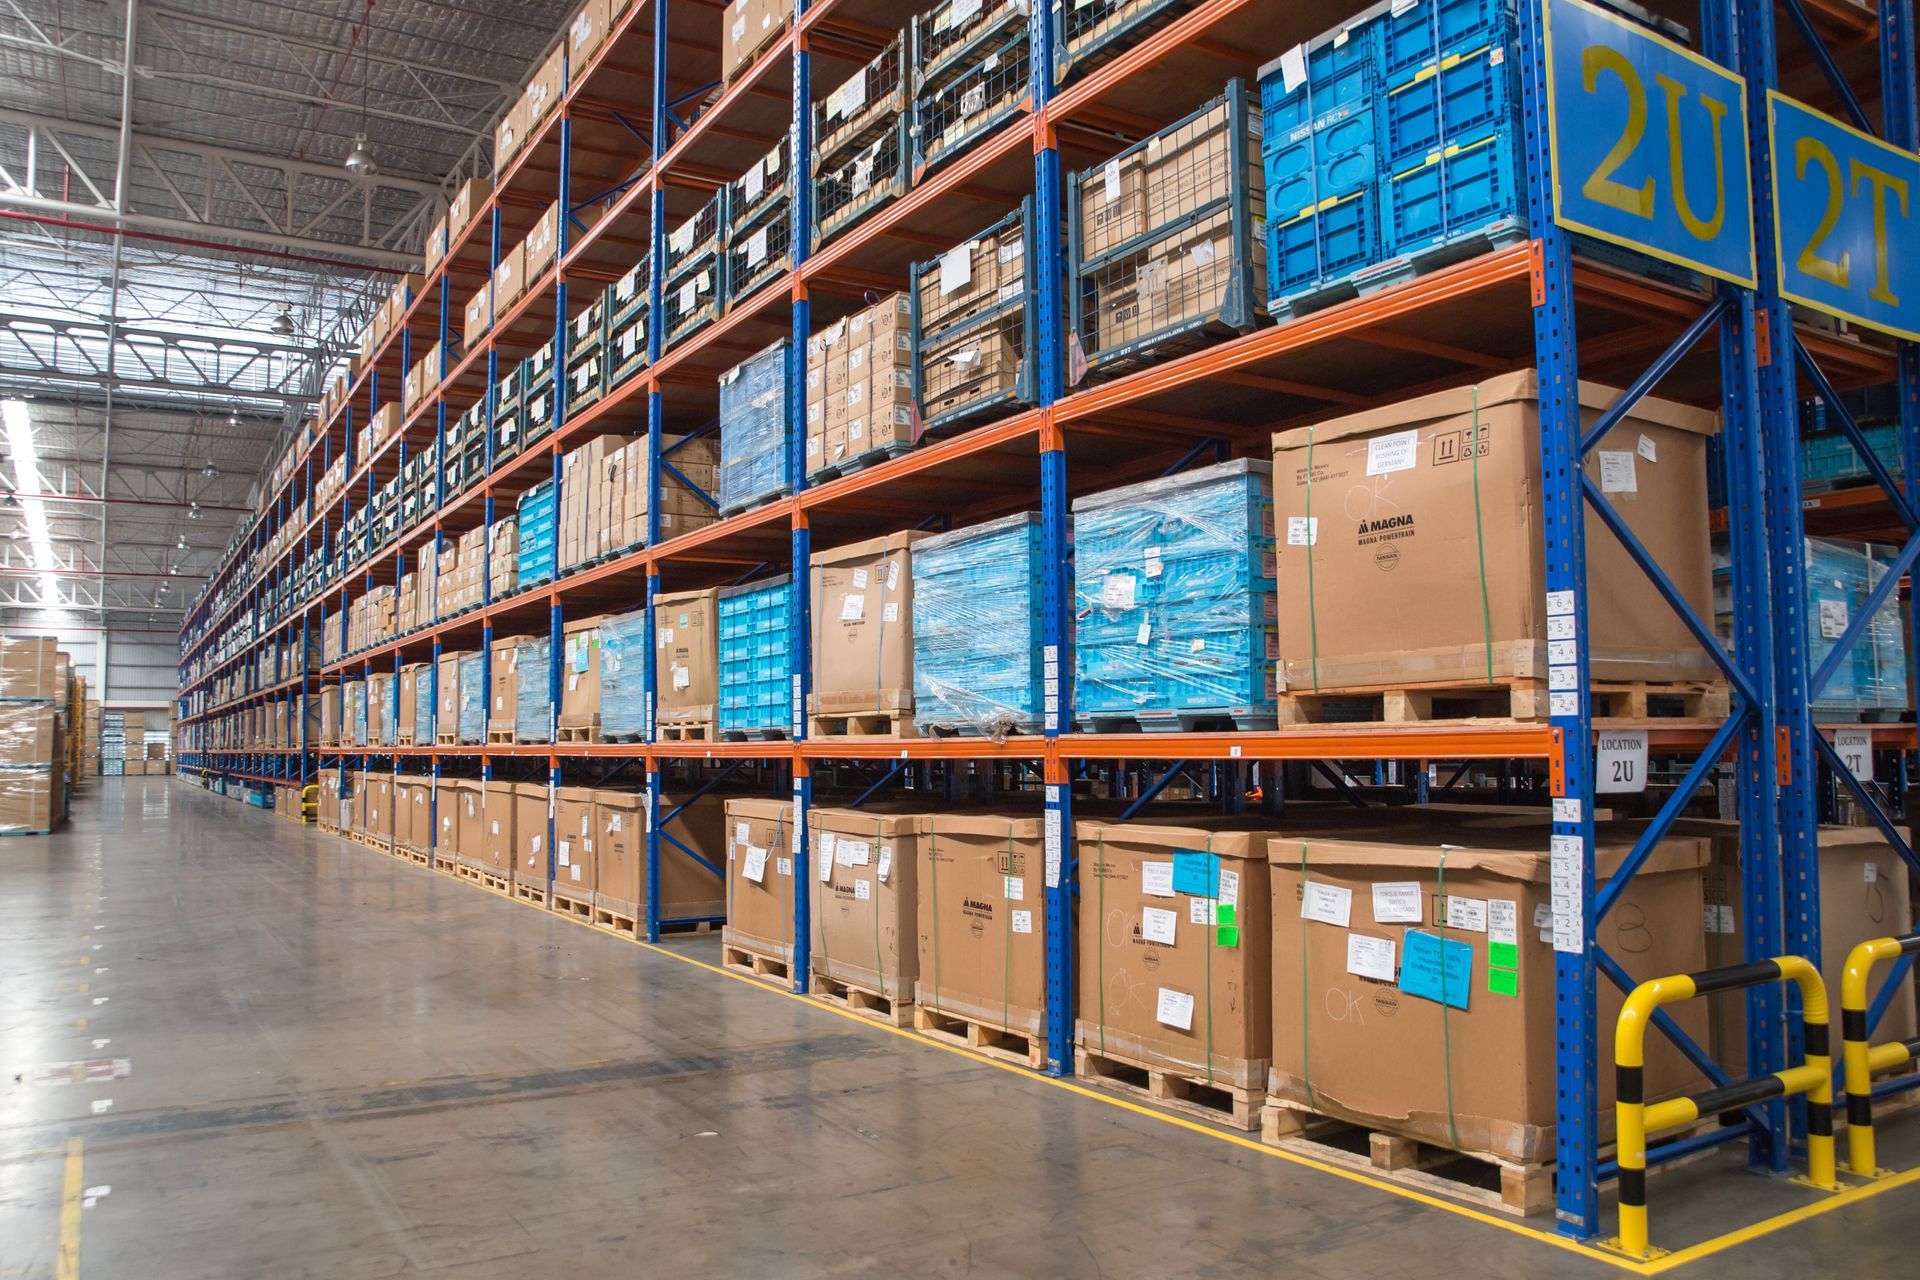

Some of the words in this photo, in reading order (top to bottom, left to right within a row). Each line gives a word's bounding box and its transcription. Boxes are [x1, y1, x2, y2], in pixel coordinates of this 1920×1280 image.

[1581, 44, 1728, 242] 2U
[1795, 136, 1909, 308] 2T
[1375, 441, 1392, 451] CLEAN
[1392, 439, 1411, 447] POINT
[1377, 459, 1405, 469] GERMANY
[1344, 478, 1400, 522] OK
[1371, 514, 1414, 532] MAGNA
[1358, 536, 1377, 546] MAGNA
[1379, 529, 1415, 543] POWERTRAIN
[1376, 553, 1399, 561] NISSAN
[1556, 599, 1562, 608] 6
[1557, 623, 1563, 632] 5
[1558, 647, 1564, 656] 4
[1559, 673, 1565, 682] 3
[1559, 699, 1566, 708] 2
[1602, 738, 1642, 751] LOCATION
[1837, 736, 1868, 746] LOCATION
[1845, 754, 1862, 773] 2T
[1612, 760, 1634, 782] 2U
[1563, 806, 1568, 814] 1
[1563, 843, 1569, 852] 6
[1564, 862, 1570, 871] 5
[1564, 881, 1570, 889] 4
[970, 900, 992, 912] MAGNA
[1564, 900, 1570, 909] 3
[1564, 919, 1570, 928] 2
[1566, 938, 1570, 946] 1
[1326, 987, 1365, 1025] OK
[1375, 998, 1397, 1006] NISSAN
